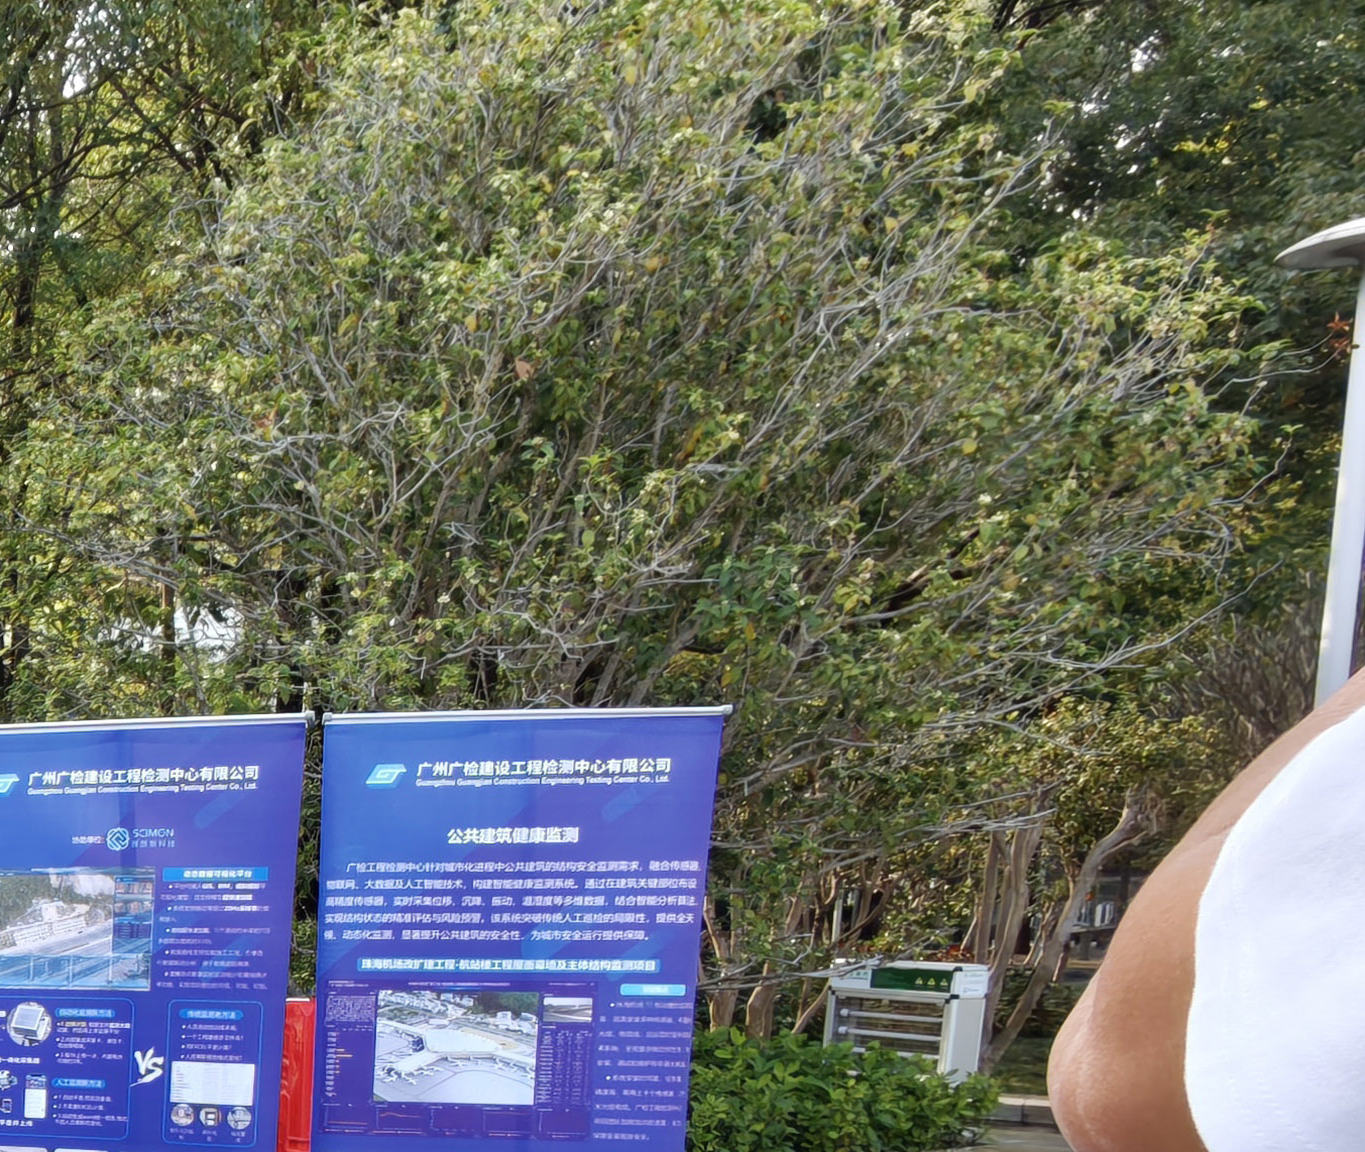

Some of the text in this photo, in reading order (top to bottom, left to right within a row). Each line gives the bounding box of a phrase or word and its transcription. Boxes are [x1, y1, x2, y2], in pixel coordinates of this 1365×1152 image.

[28, 765, 260, 786] 广州广检建设工程检测中心有限公司
[416, 757, 671, 777] 广州广检建设工程检测中心有限公司
[447, 826, 579, 844] 公共建筑健康监测
[131, 1047, 165, 1087] VS
